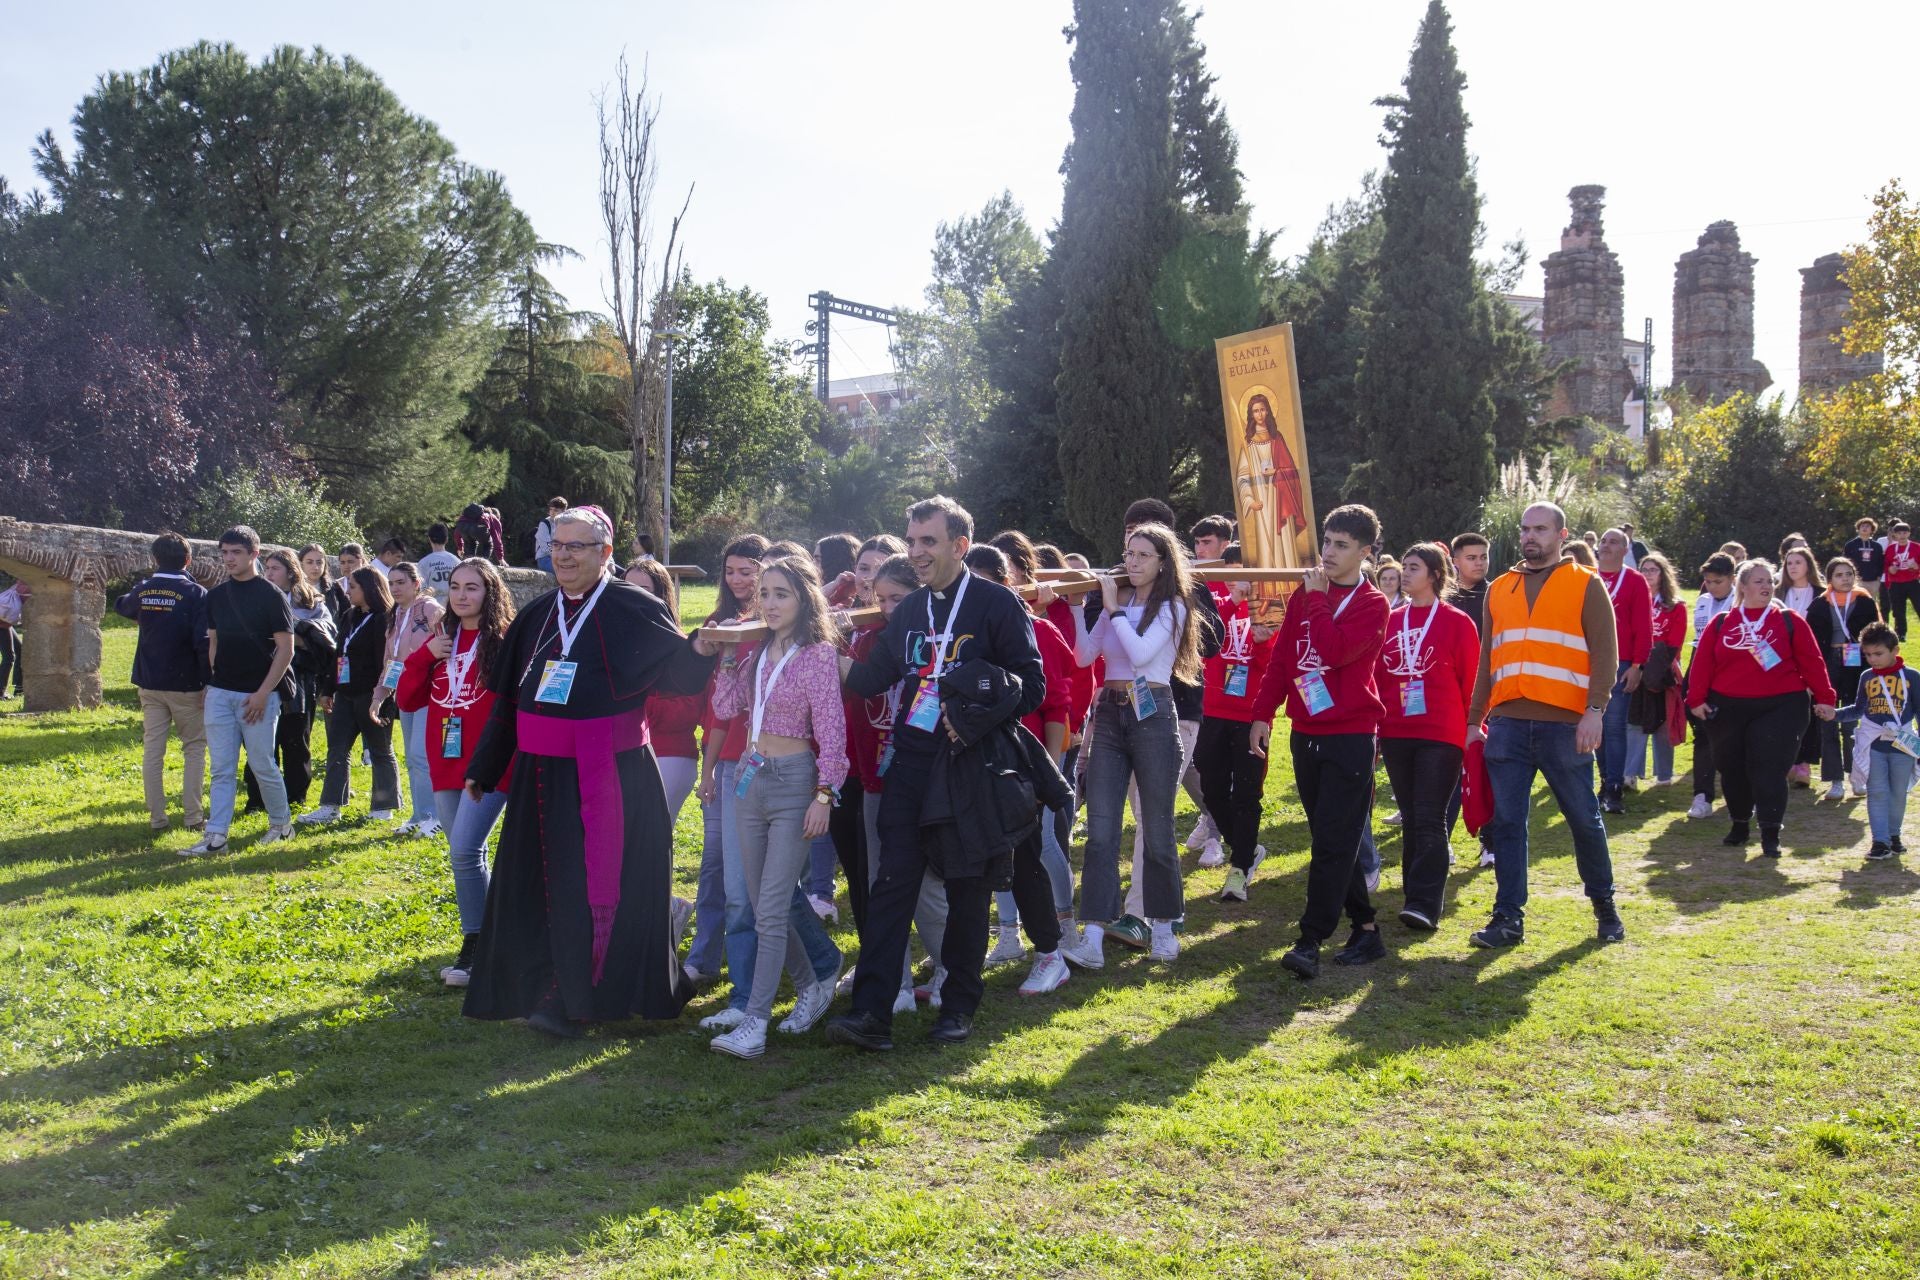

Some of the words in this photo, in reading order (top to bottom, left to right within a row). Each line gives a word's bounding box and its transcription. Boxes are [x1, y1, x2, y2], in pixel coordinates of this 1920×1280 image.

[1232, 345, 1270, 361] SANTA
[1229, 359, 1278, 377] EULALIA
[141, 598, 176, 606] SEMINARIO
